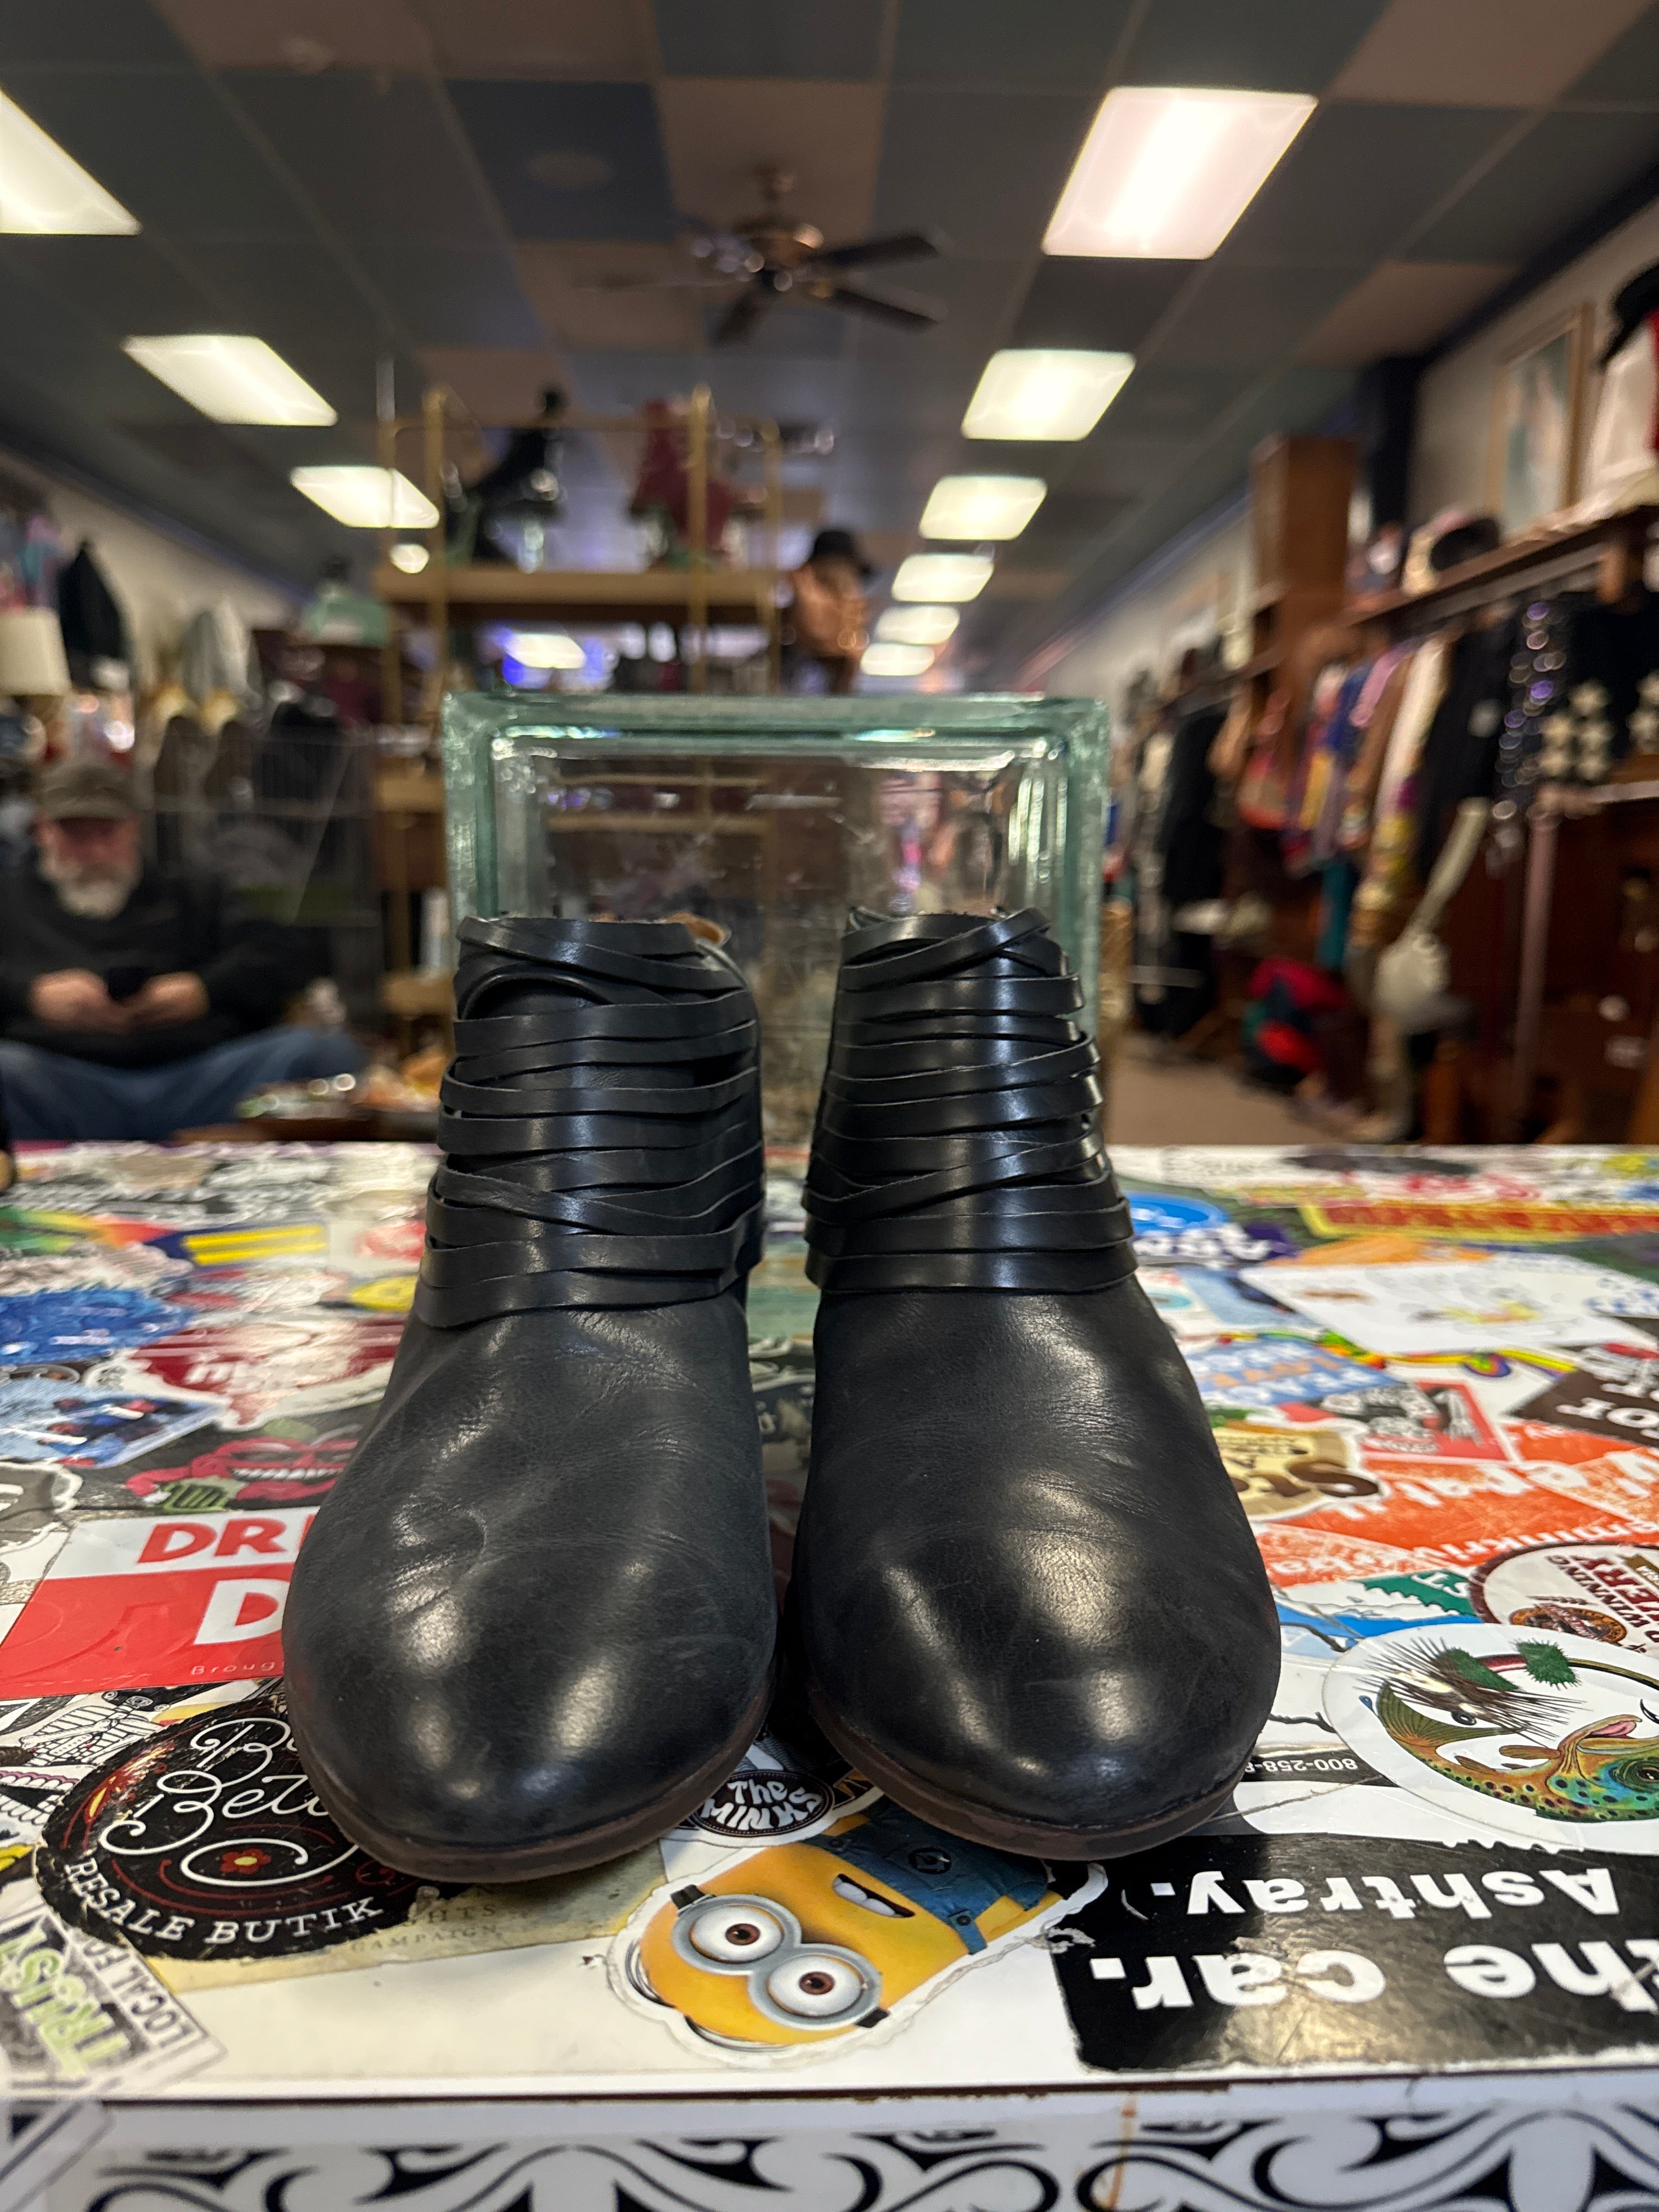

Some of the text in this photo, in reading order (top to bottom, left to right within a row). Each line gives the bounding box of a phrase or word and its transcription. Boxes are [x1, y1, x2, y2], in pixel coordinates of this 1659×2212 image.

[137, 1513, 317, 1564] DR
[1545, 1555, 1650, 1628] WINNING
[191, 1661, 284, 1675] Broug
[1245, 1758, 1358, 1773] 800-258-8
[65, 1858, 384, 1944] RESALE BUTIK
[1150, 1867, 1621, 1920] Ashtray.
[111, 1965, 195, 2049] LOCAL
[1091, 1949, 1386, 2010] car.
